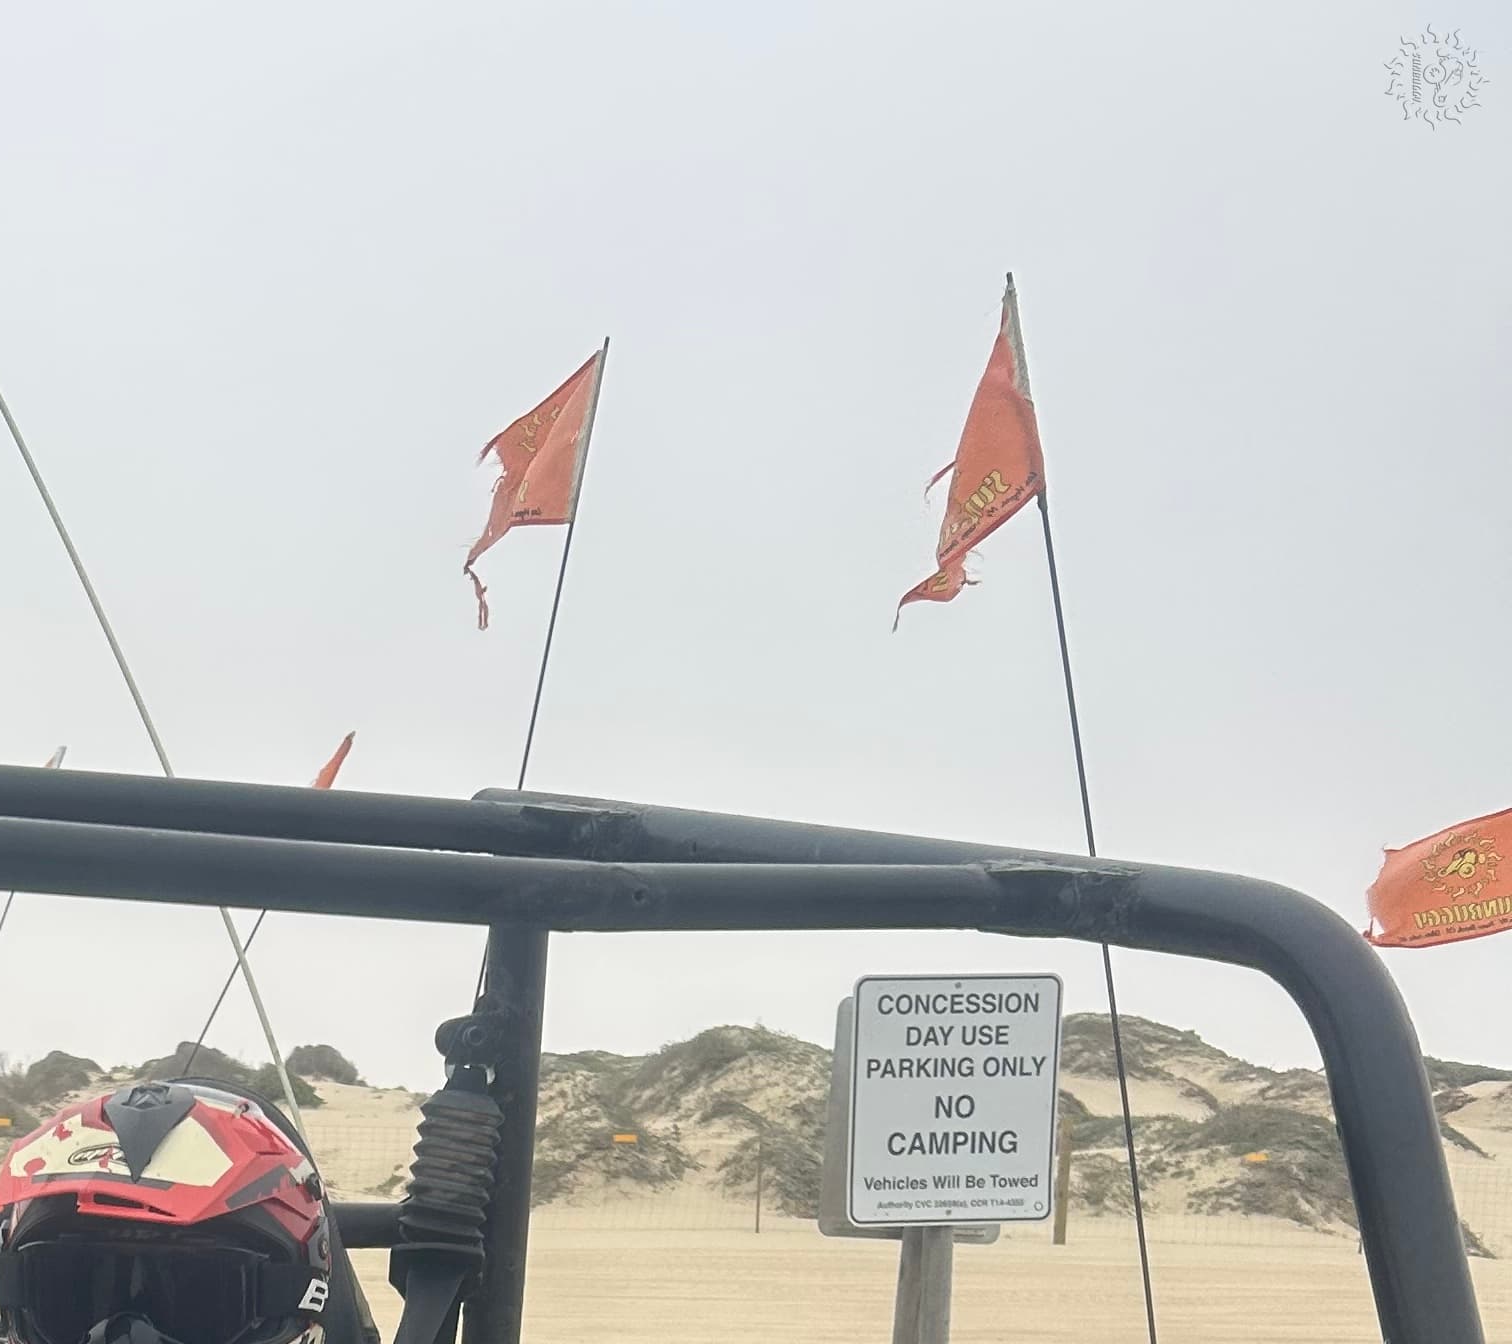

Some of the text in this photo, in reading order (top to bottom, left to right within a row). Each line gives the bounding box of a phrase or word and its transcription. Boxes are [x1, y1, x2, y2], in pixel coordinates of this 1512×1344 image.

[877, 993, 1040, 1015] CONCESSION
[905, 1025, 1010, 1047] DAY USE
[866, 1056, 1047, 1079] PARKING ONLY
[934, 1095, 975, 1119] NO
[887, 1130, 1018, 1156] CAMPING
[863, 1174, 1039, 1191] Vehicles Will Be Towed
